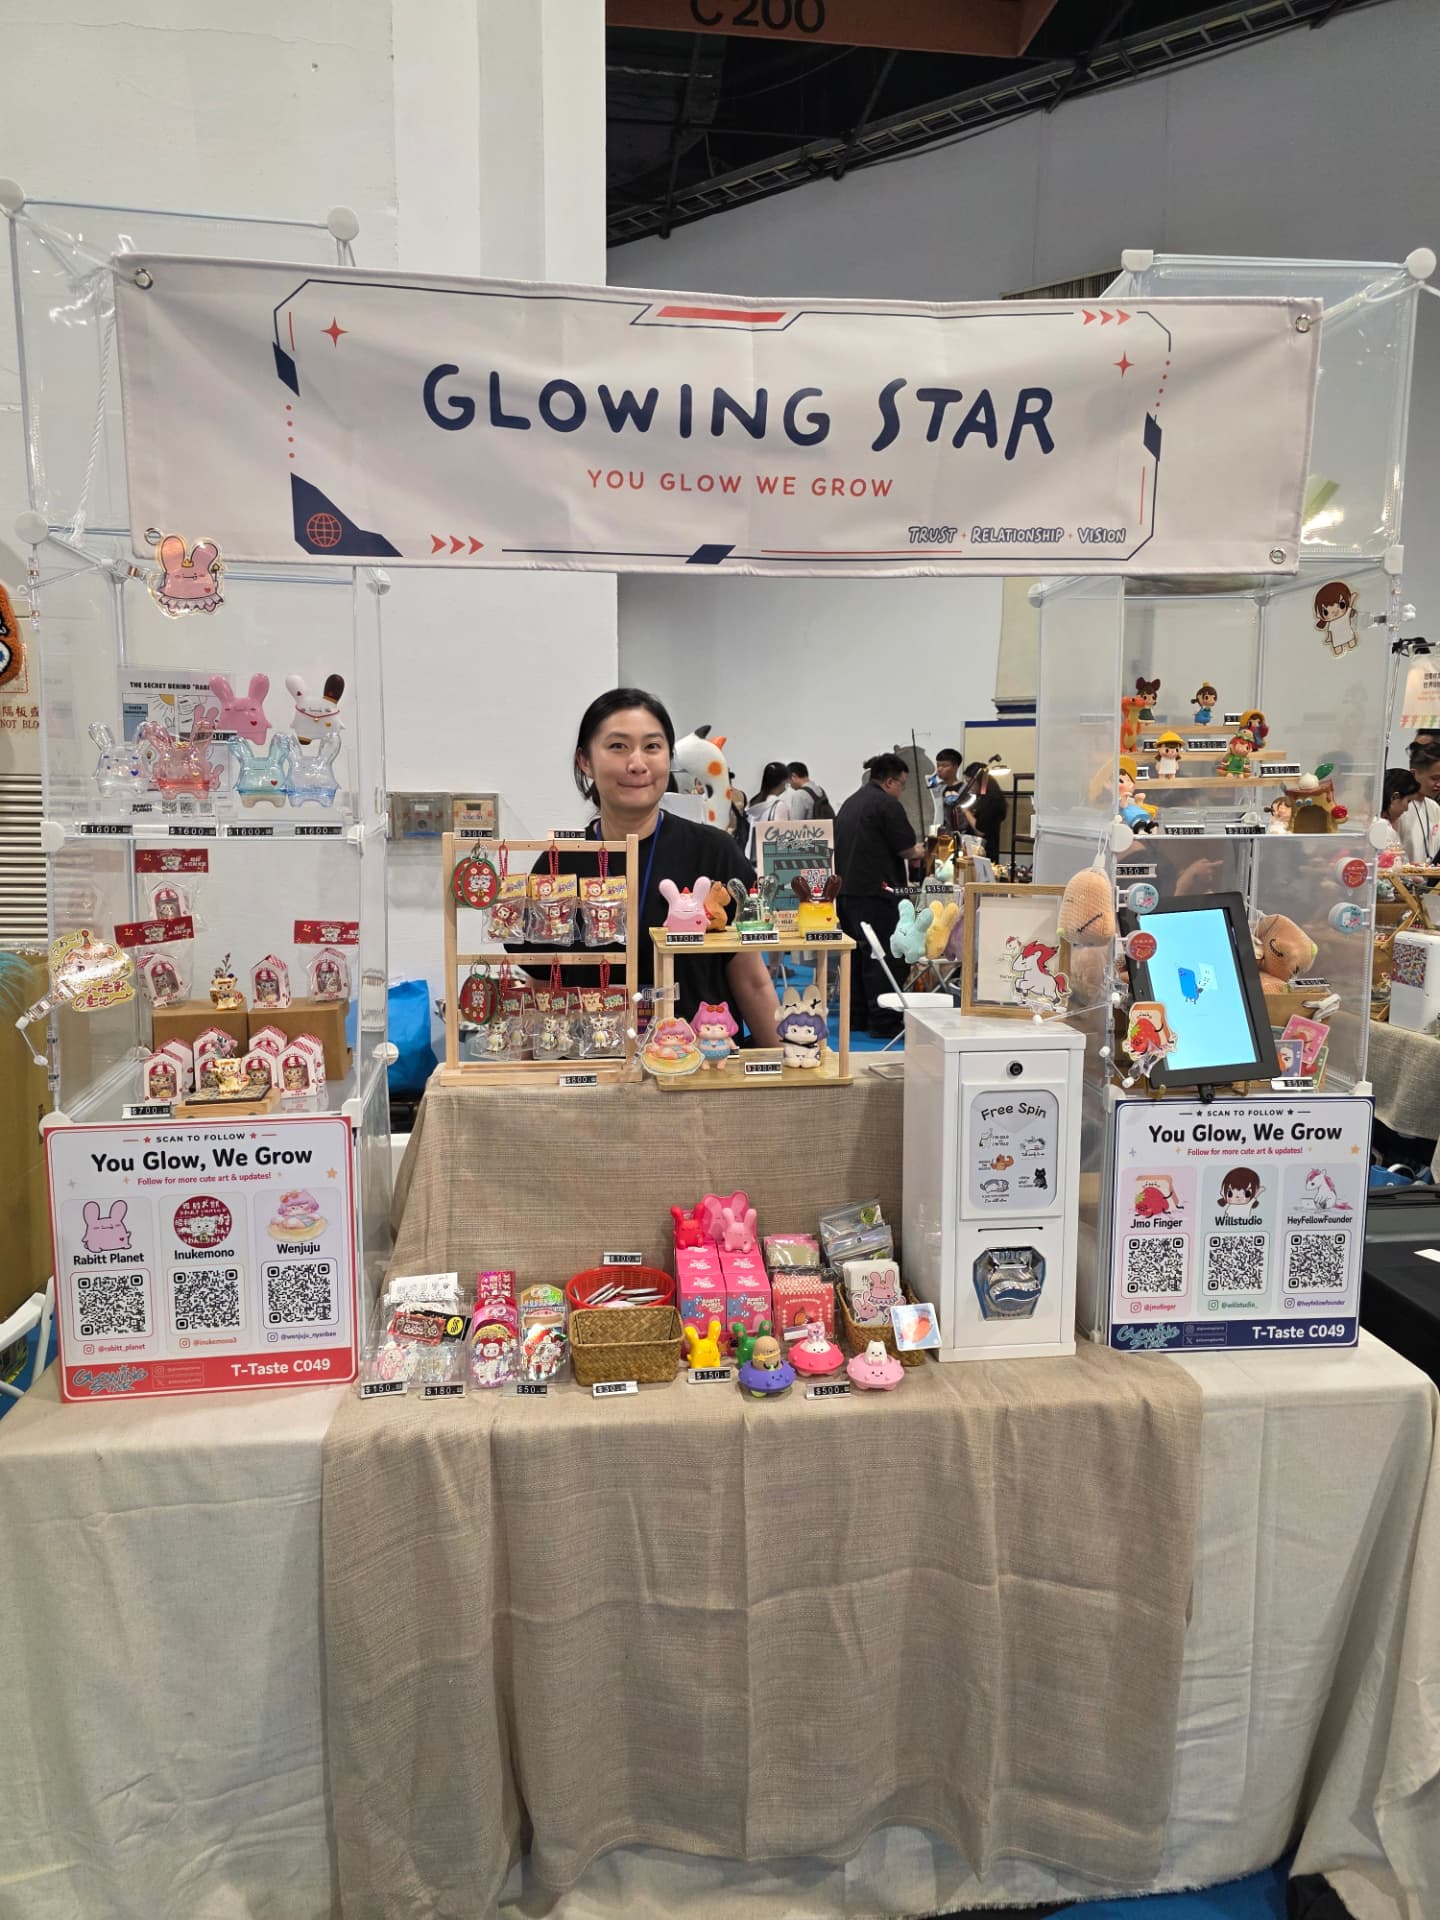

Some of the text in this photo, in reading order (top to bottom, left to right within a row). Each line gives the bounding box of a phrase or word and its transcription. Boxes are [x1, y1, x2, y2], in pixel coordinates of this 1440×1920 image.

[422, 362, 1055, 460] GLOWING STAR
[587, 468, 894, 498] YOU GLOW WE GROW
[908, 524, 1127, 545] TRUST RELATIONSHIP VISION
[764, 825, 825, 840] GLOWING
[981, 1102, 1046, 1121] Free Spin
[156, 1136, 184, 1144] SCAN
[204, 1133, 246, 1141] FOLLOW
[1149, 1122, 1343, 1144] You Glow, We Grow
[1187, 1148, 1209, 1156] Follow
[1210, 1147, 1221, 1155] for
[1240, 1147, 1256, 1155] cute
[1275, 1146, 1303, 1156] updates!
[91, 1146, 312, 1173] You Glow, We Grow
[137, 1171, 272, 1186] Follow for more cute art & updates!
[1130, 1217, 1183, 1230] Jmo Finger
[1215, 1215, 1263, 1226] Willstudio
[1287, 1215, 1353, 1226] HeyFellowFounder
[174, 1248, 235, 1260] Inukemono
[277, 1243, 321, 1255] Wenjuju
[73, 1252, 145, 1266] Rabitt Planet
[1252, 1324, 1345, 1339] T-Taste C049
[232, 1358, 331, 1377] T-Taste C049
